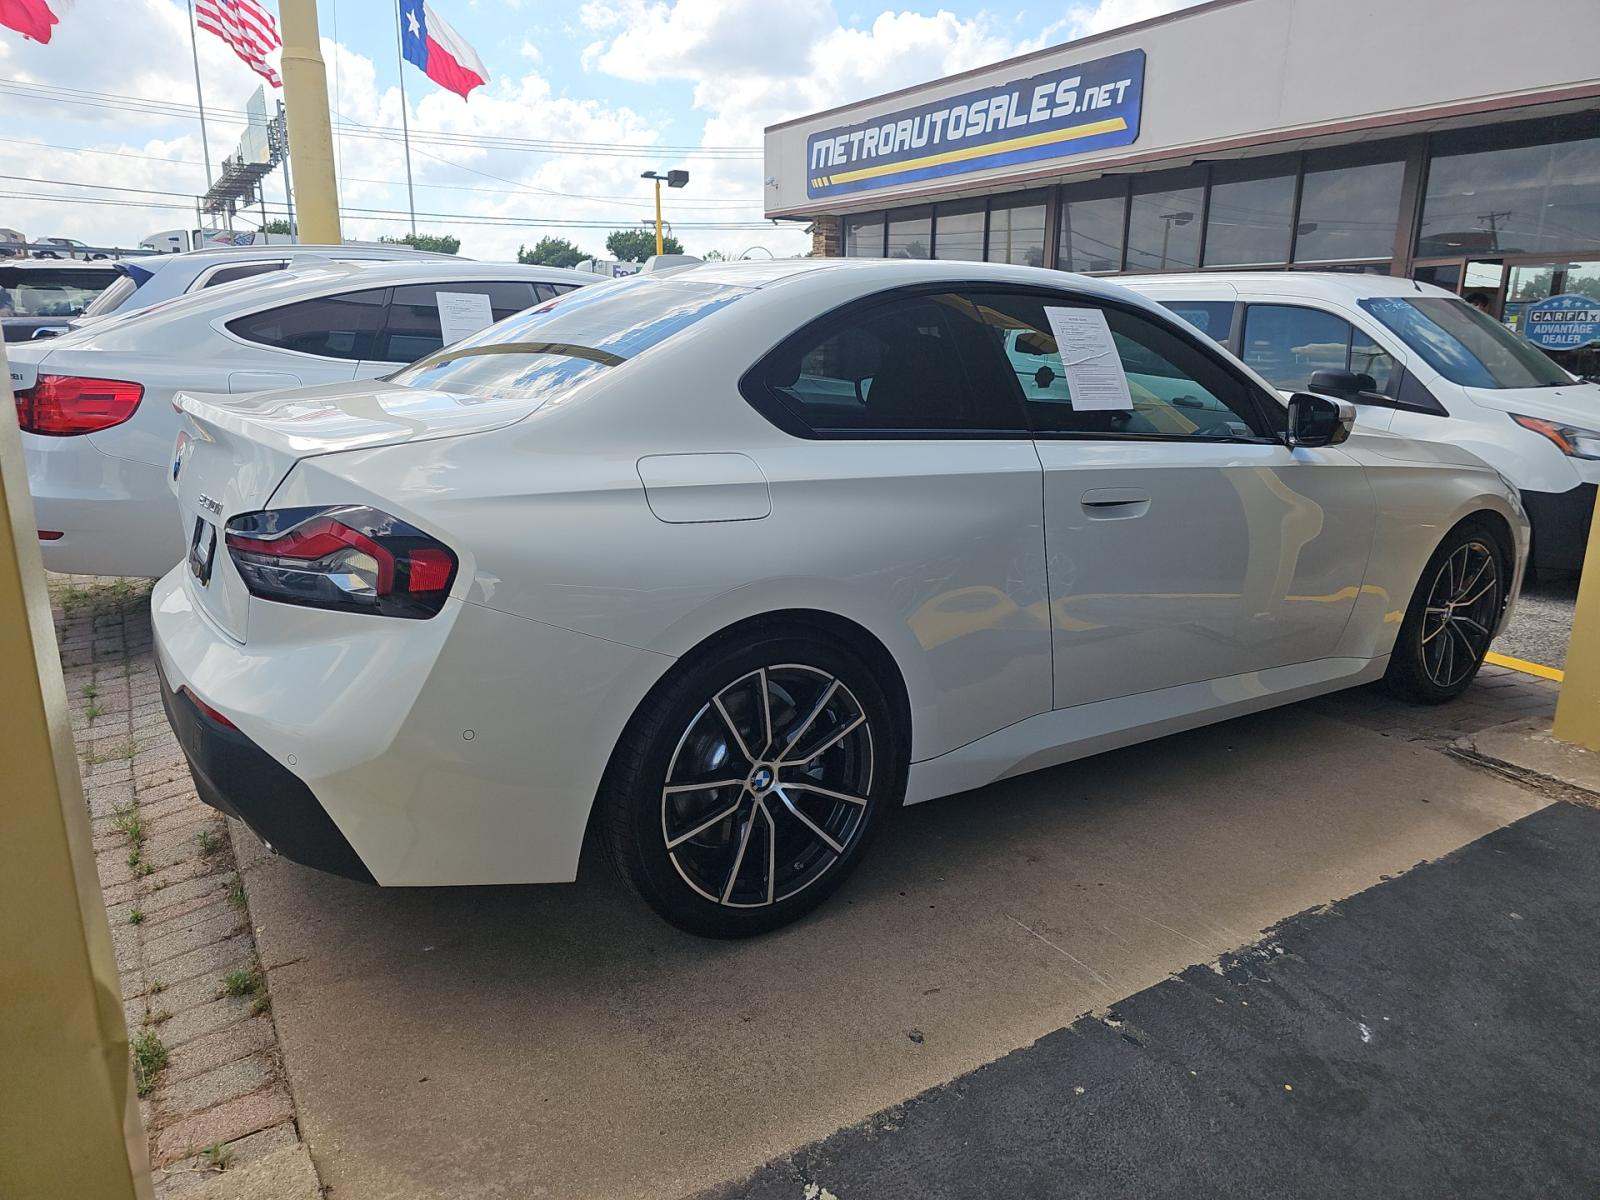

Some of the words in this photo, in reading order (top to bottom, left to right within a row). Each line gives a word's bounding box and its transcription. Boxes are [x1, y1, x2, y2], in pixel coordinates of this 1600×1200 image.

[1532, 311, 1600, 322] CARFAX
[1533, 324, 1593, 334] ADVANTAGE
[1542, 334, 1581, 344] DEALER
